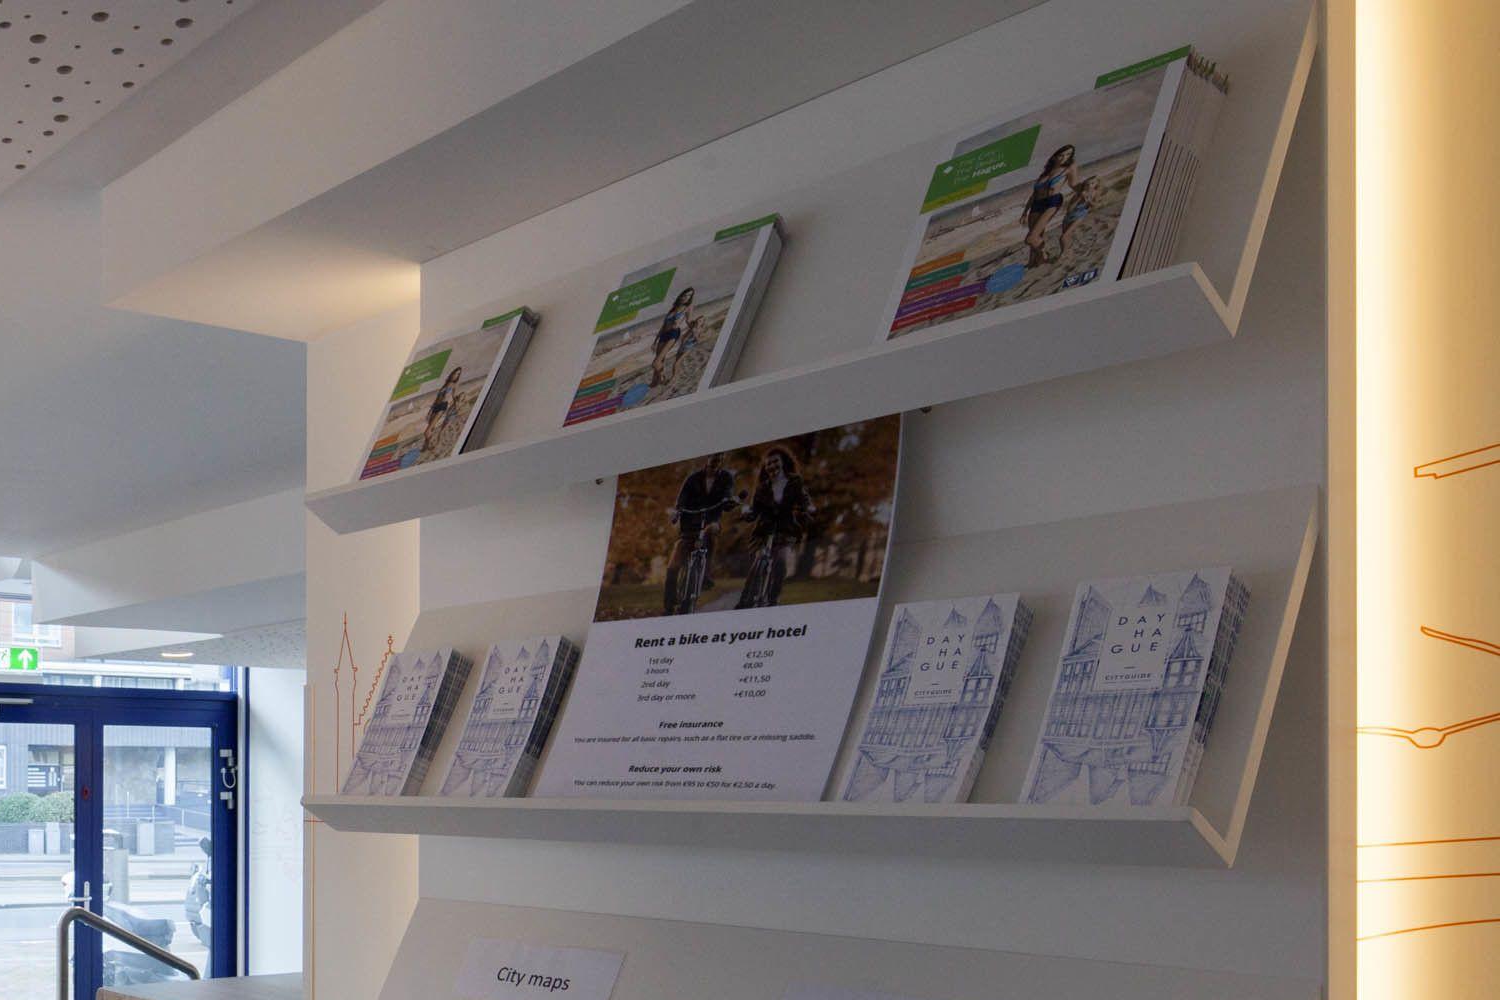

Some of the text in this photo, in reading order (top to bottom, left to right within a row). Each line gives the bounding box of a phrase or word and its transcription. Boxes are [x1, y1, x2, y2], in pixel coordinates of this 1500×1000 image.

[1118, 613, 1165, 626] DAY
[635, 625, 807, 648] Rent a bike at your hotel
[1134, 628, 1163, 638] HA
[926, 633, 965, 645] DAY
[938, 647, 962, 657] HA
[1111, 641, 1159, 654] GUE
[649, 656, 674, 665] 1st day
[504, 666, 528, 675] DAY
[651, 667, 669, 675] hours
[920, 660, 960, 672] GUE
[657, 680, 671, 689] day
[498, 686, 522, 694] GUE
[637, 694, 649, 702] 3rd
[650, 694, 664, 703] day
[675, 693, 696, 701] more
[679, 720, 724, 728] insurance
[628, 765, 659, 773] Reduce
[704, 765, 722, 773] risk
[496, 966, 570, 992] City maps
